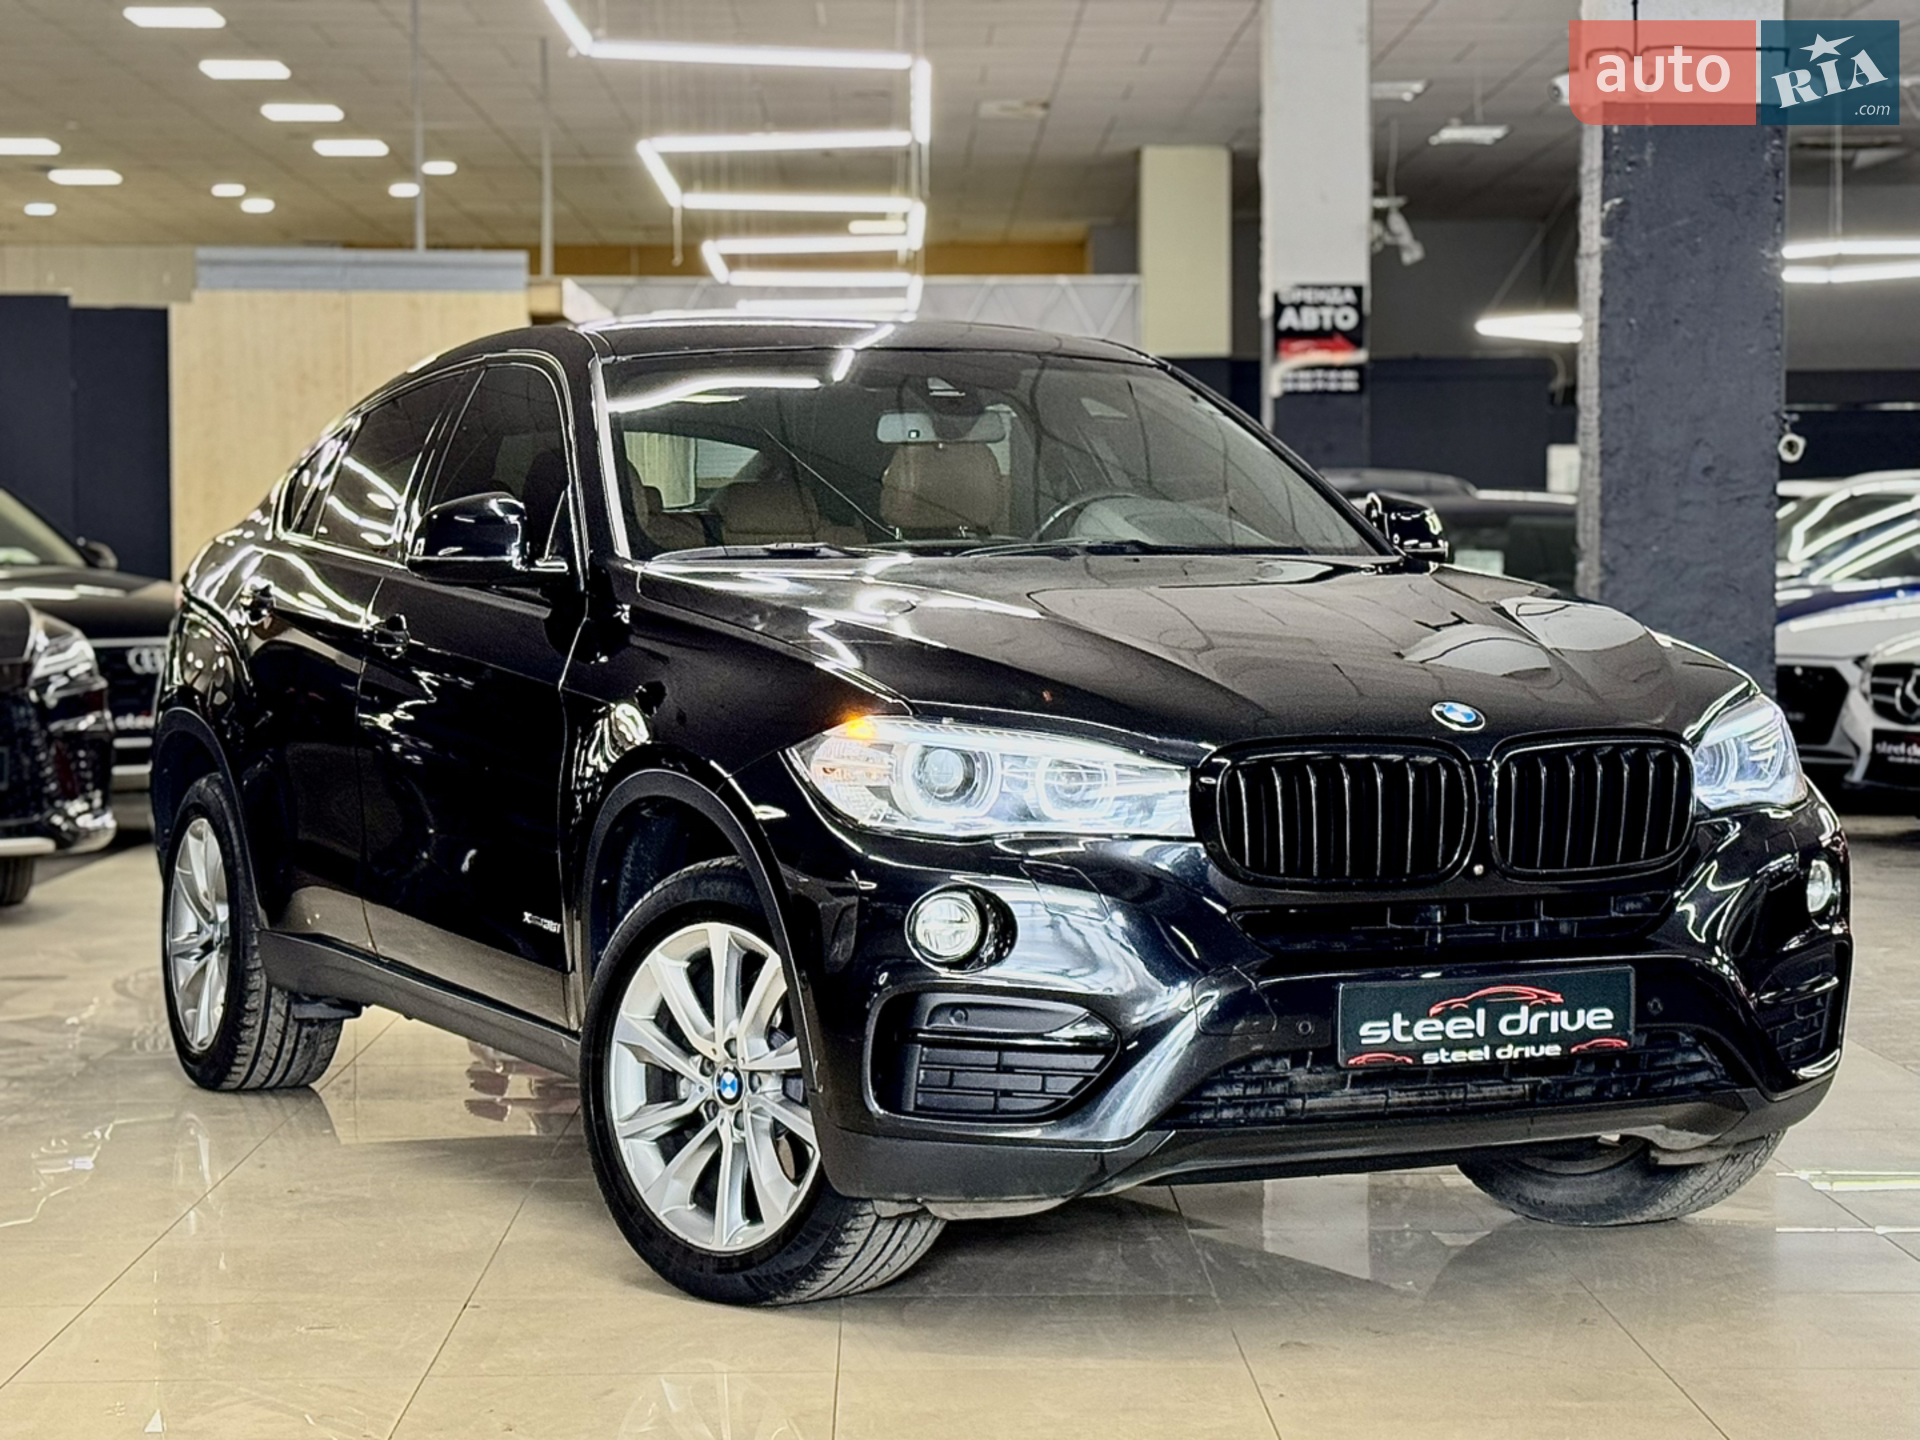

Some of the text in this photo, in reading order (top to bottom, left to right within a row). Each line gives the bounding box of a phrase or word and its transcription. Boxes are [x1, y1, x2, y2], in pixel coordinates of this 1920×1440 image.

[1277, 304, 1360, 331] АВТО
[1359, 1005, 1614, 1045] steel drive
[1422, 1043, 1562, 1065] steel drive
